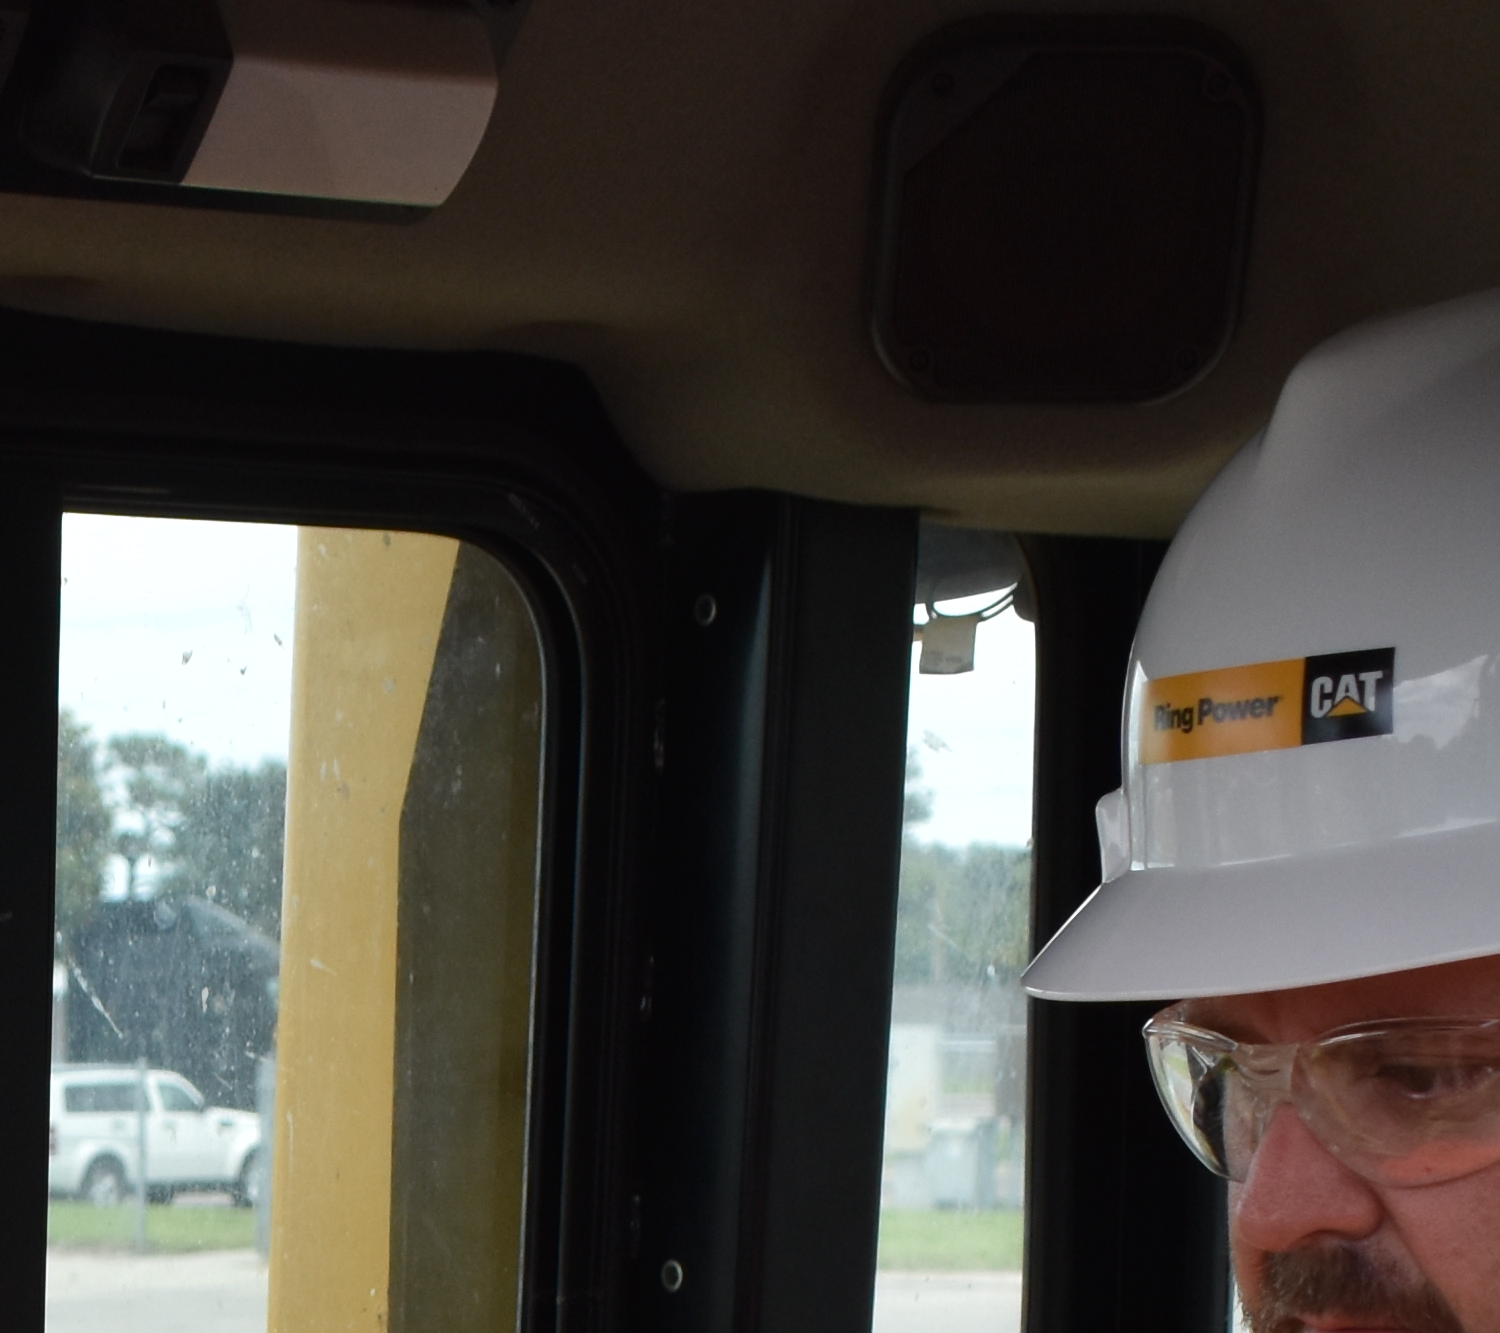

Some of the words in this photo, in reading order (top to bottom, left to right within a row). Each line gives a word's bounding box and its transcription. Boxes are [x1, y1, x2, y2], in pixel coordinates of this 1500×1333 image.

[1154, 703, 1194, 734] Ring
[1198, 695, 1278, 726] Power
[1310, 670, 1383, 719] CAT
